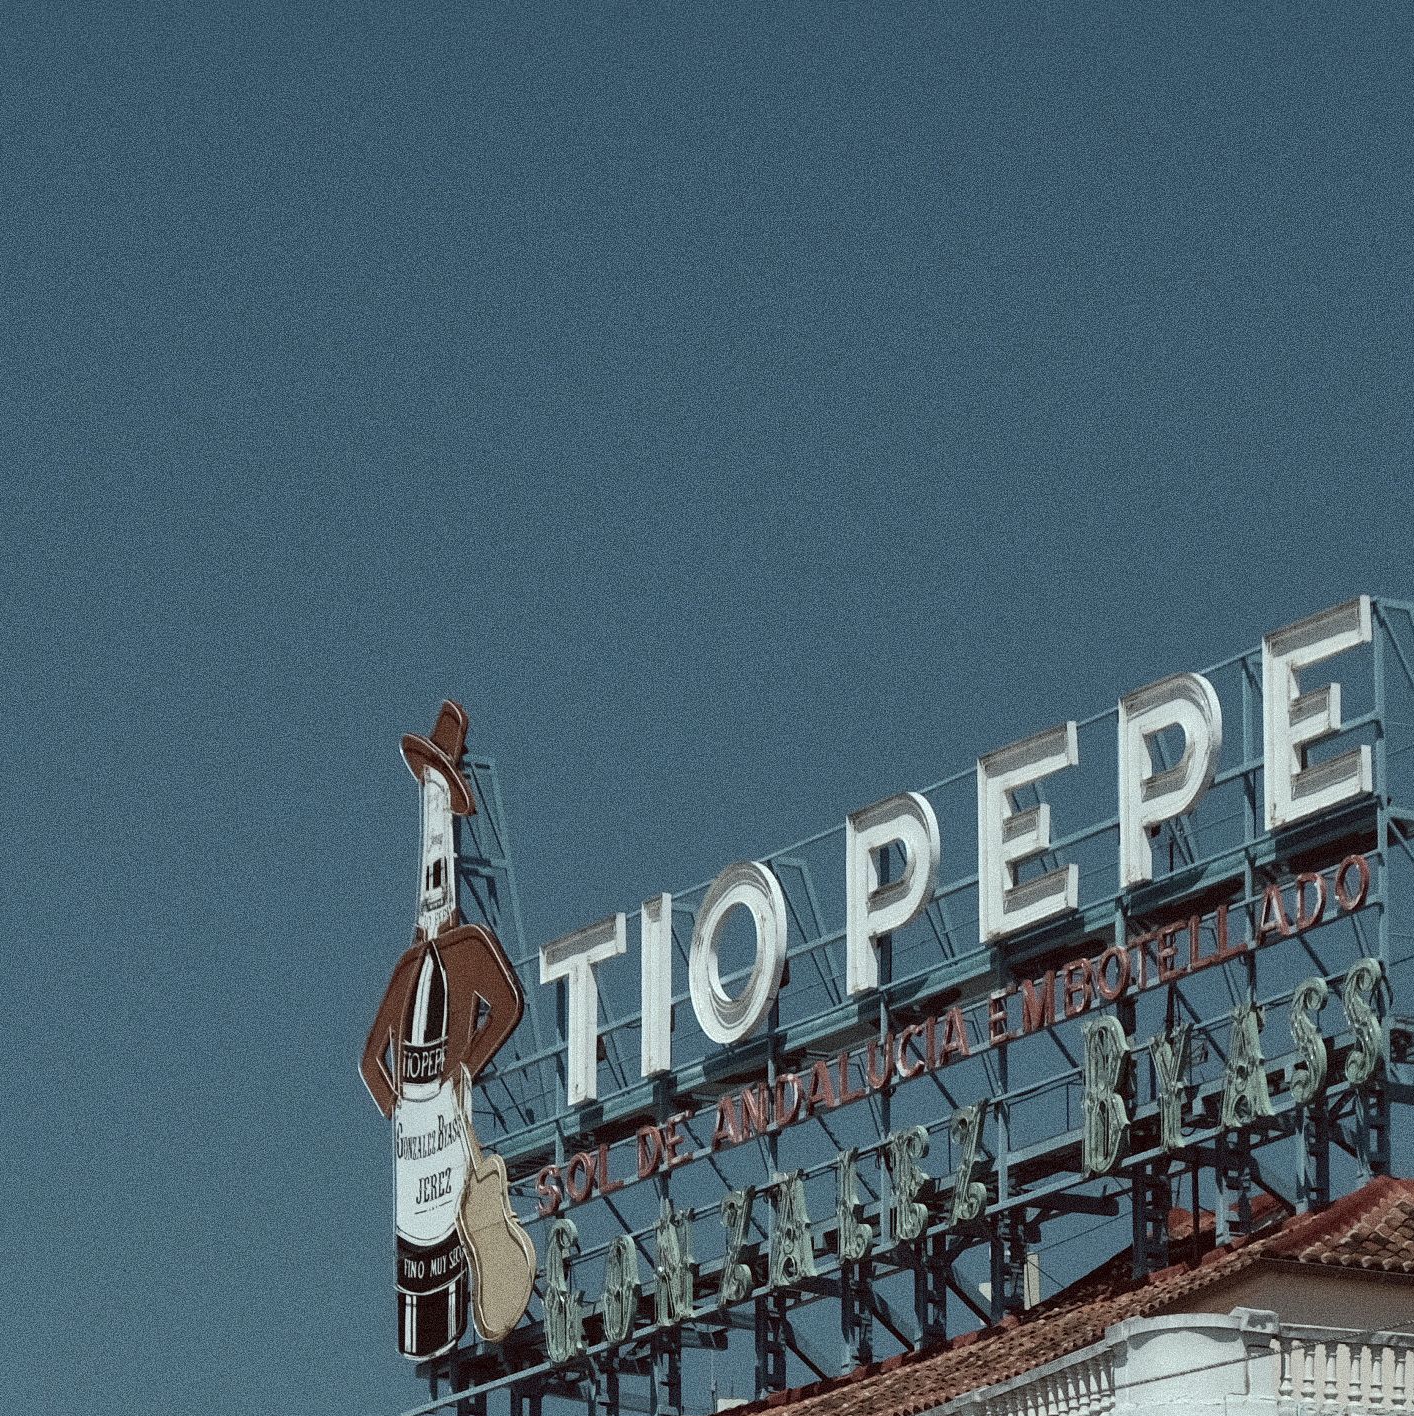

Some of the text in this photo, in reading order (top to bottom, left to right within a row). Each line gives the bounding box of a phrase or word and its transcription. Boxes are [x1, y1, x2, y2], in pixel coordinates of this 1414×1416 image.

[541, 595, 1372, 1104] TIO PEPE
[416, 1167, 453, 1205] JEREZ
[536, 854, 1370, 1217] SOL DE ANDALUCIA EMBOTELLADO
[541, 957, 1384, 1365] GONZALEZ BYASS
[404, 1258, 425, 1279] FINO
[430, 1257, 447, 1277] MUY
